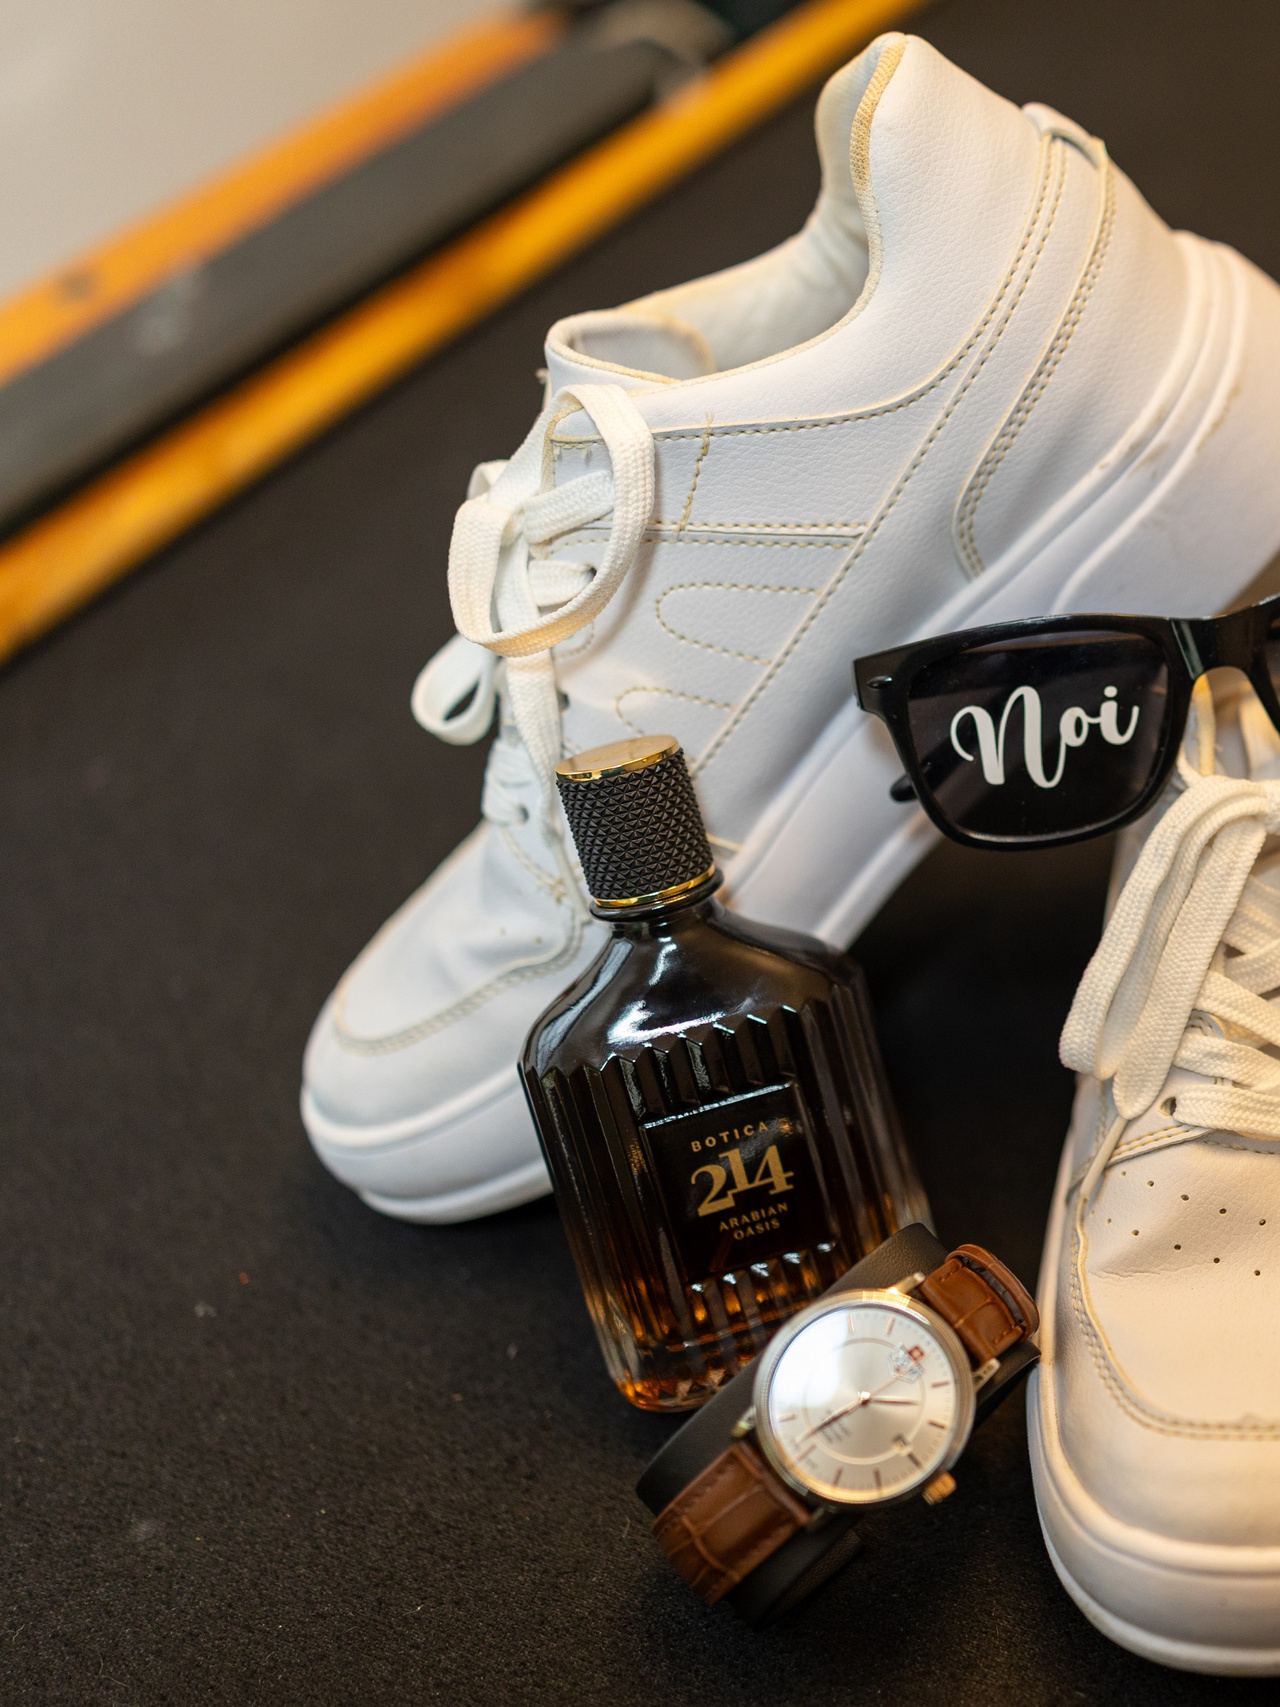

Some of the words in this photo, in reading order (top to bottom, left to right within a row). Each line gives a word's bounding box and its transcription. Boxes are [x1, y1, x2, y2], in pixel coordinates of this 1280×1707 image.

[950, 686, 1139, 788] Noi
[691, 1121, 769, 1153] BOTICA
[691, 1145, 794, 1217] 214
[719, 1203, 788, 1232] ARABIAN
[733, 1218, 780, 1240] OASIS
